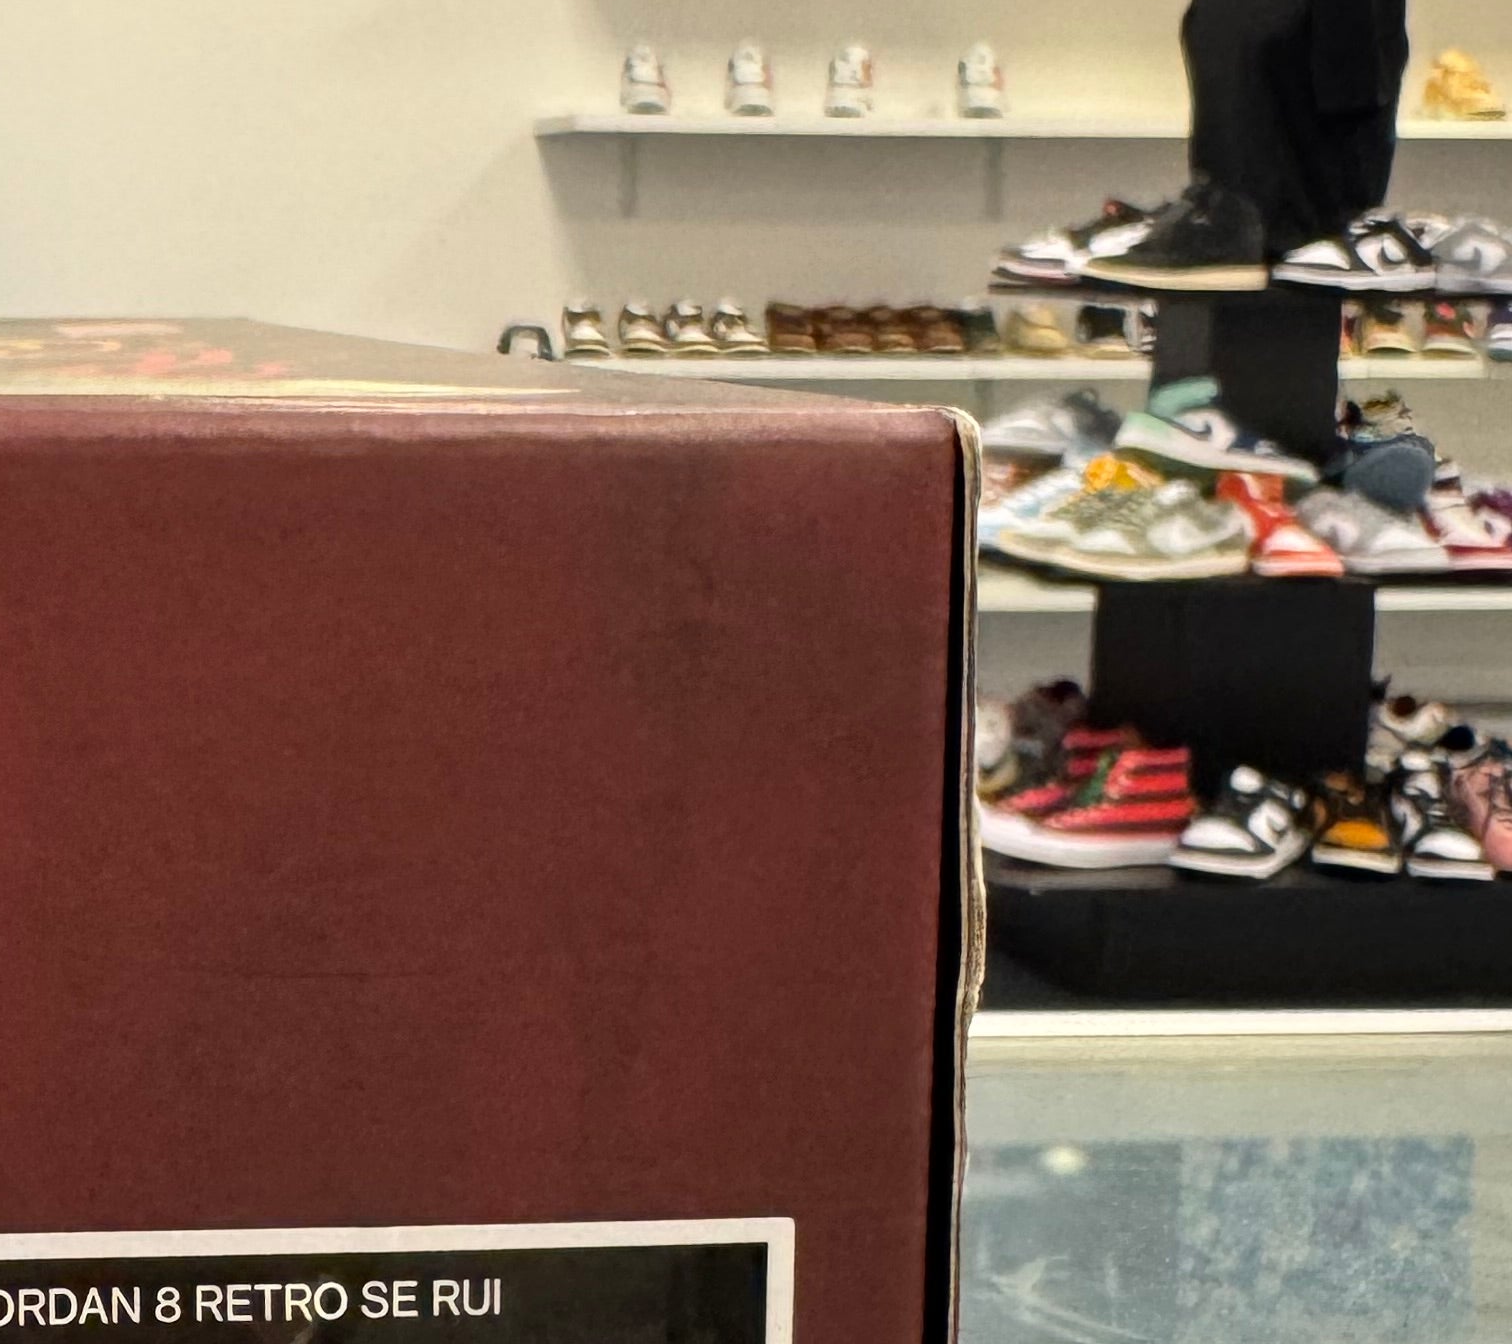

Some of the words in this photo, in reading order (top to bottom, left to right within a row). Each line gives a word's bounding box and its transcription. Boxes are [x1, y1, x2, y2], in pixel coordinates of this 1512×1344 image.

[155, 1287, 181, 1323] 8
[196, 1282, 348, 1321] RETRO
[361, 1281, 418, 1318] SE
[433, 1279, 500, 1316] RUI
